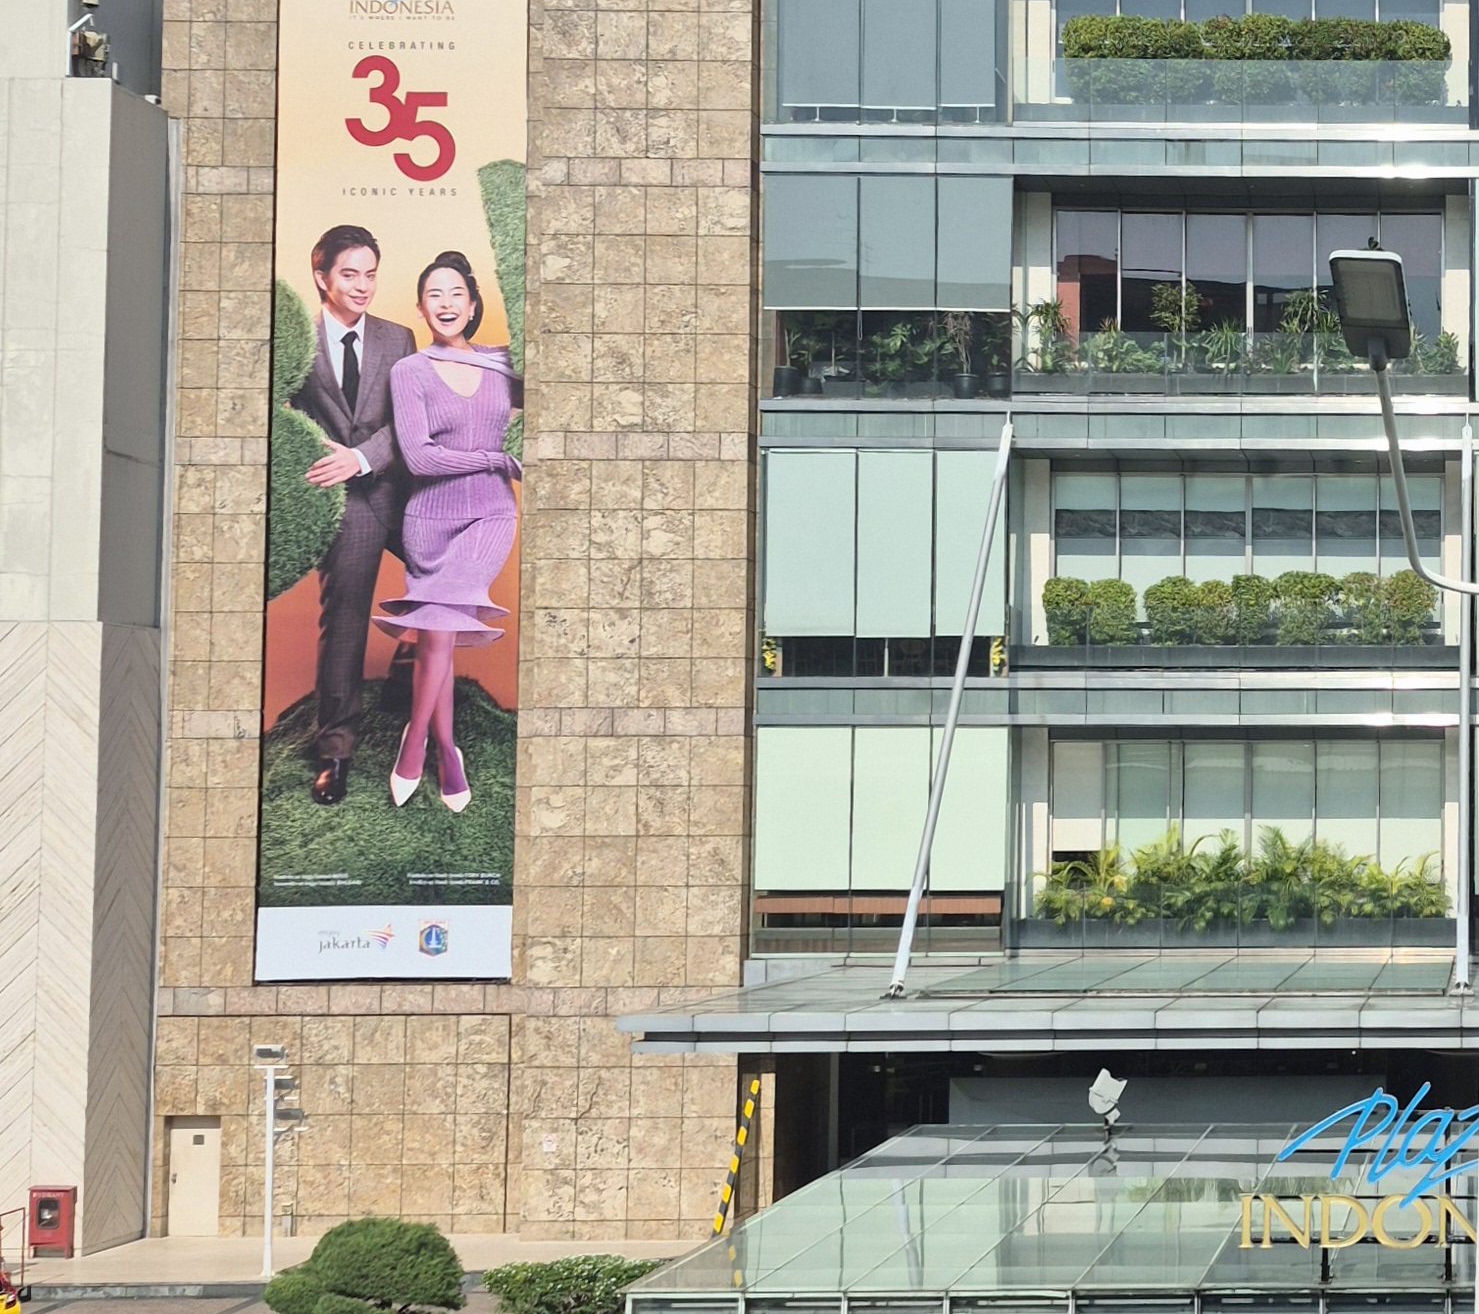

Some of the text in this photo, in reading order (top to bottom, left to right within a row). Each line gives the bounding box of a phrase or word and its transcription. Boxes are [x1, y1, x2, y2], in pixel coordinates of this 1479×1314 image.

[350, 0, 454, 14] INDONESIA
[347, 41, 455, 51] CELEBRATING
[345, 55, 456, 182] 35
[343, 188, 457, 197] ICONIC YEARS
[319, 936, 370, 953] jakarta
